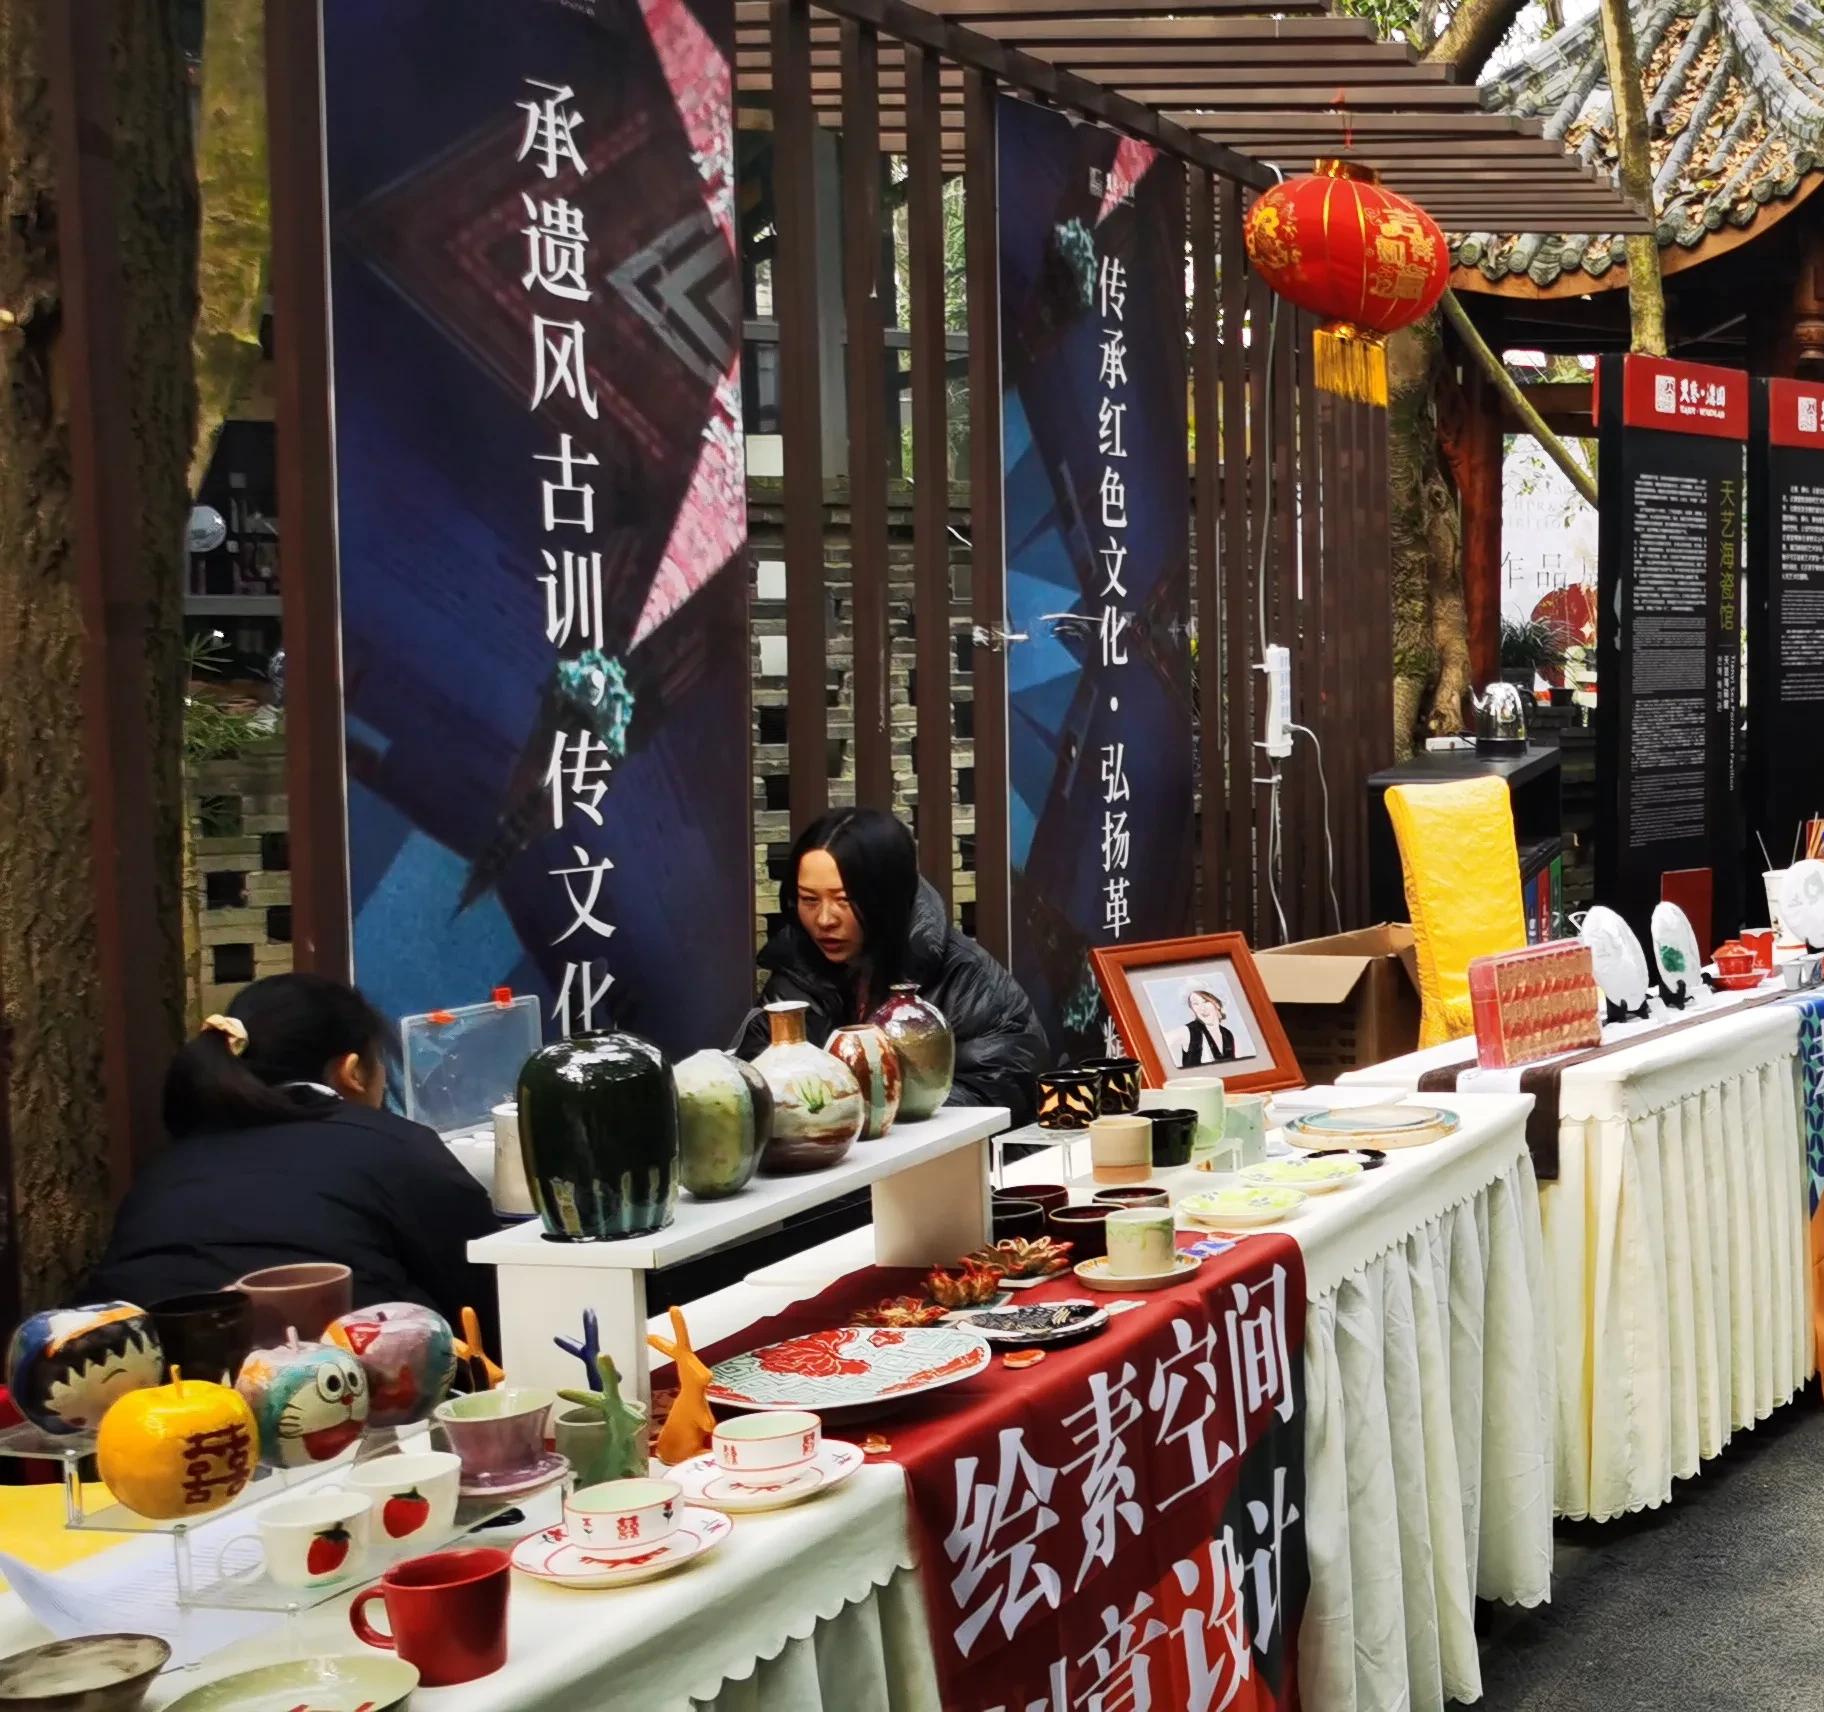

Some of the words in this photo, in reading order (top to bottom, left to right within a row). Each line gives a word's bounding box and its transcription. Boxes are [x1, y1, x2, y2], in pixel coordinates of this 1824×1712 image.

[943, 1263, 1296, 1658] 绘素空间
[982, 1466, 1301, 1712] 境设计
